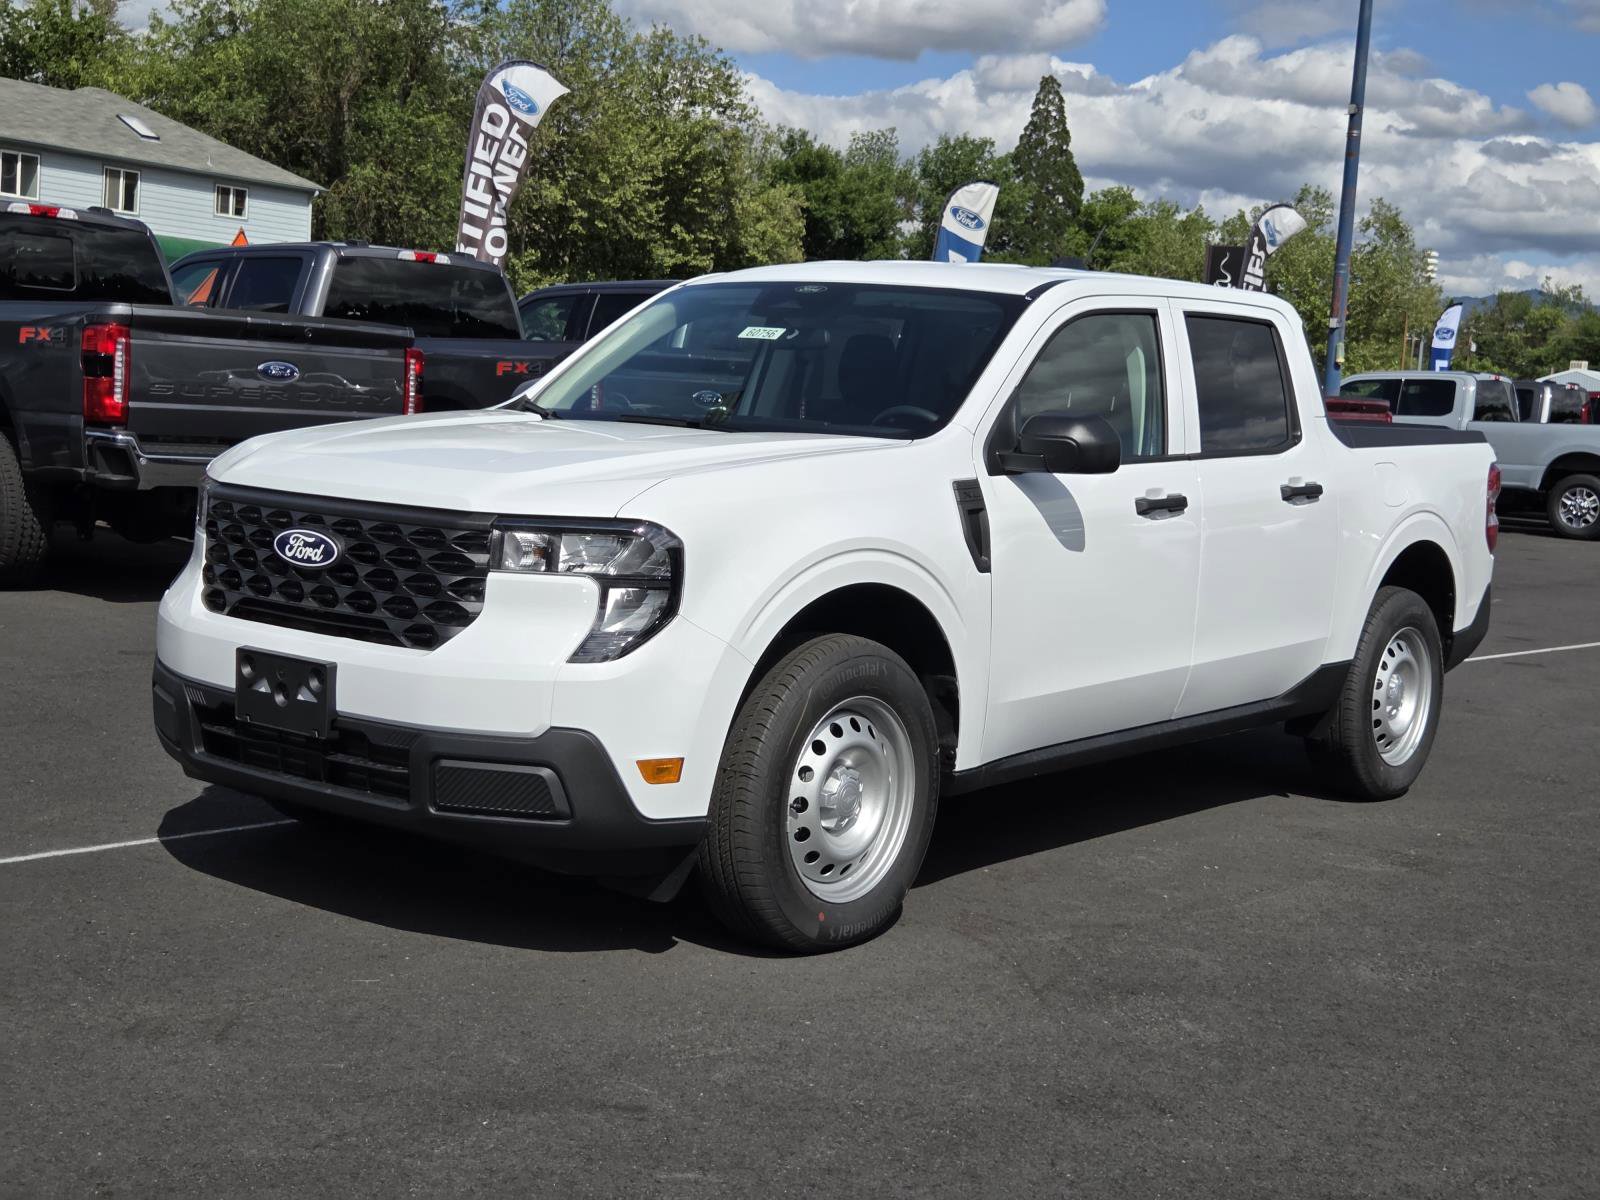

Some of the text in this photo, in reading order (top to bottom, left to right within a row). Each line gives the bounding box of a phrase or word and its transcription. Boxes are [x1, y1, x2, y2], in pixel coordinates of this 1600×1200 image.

[505, 88, 532, 112] Ford
[955, 208, 980, 230] Ford
[19, 327, 64, 343] FX4
[149, 384, 288, 400] SUPER
[283, 532, 327, 563] Ford
